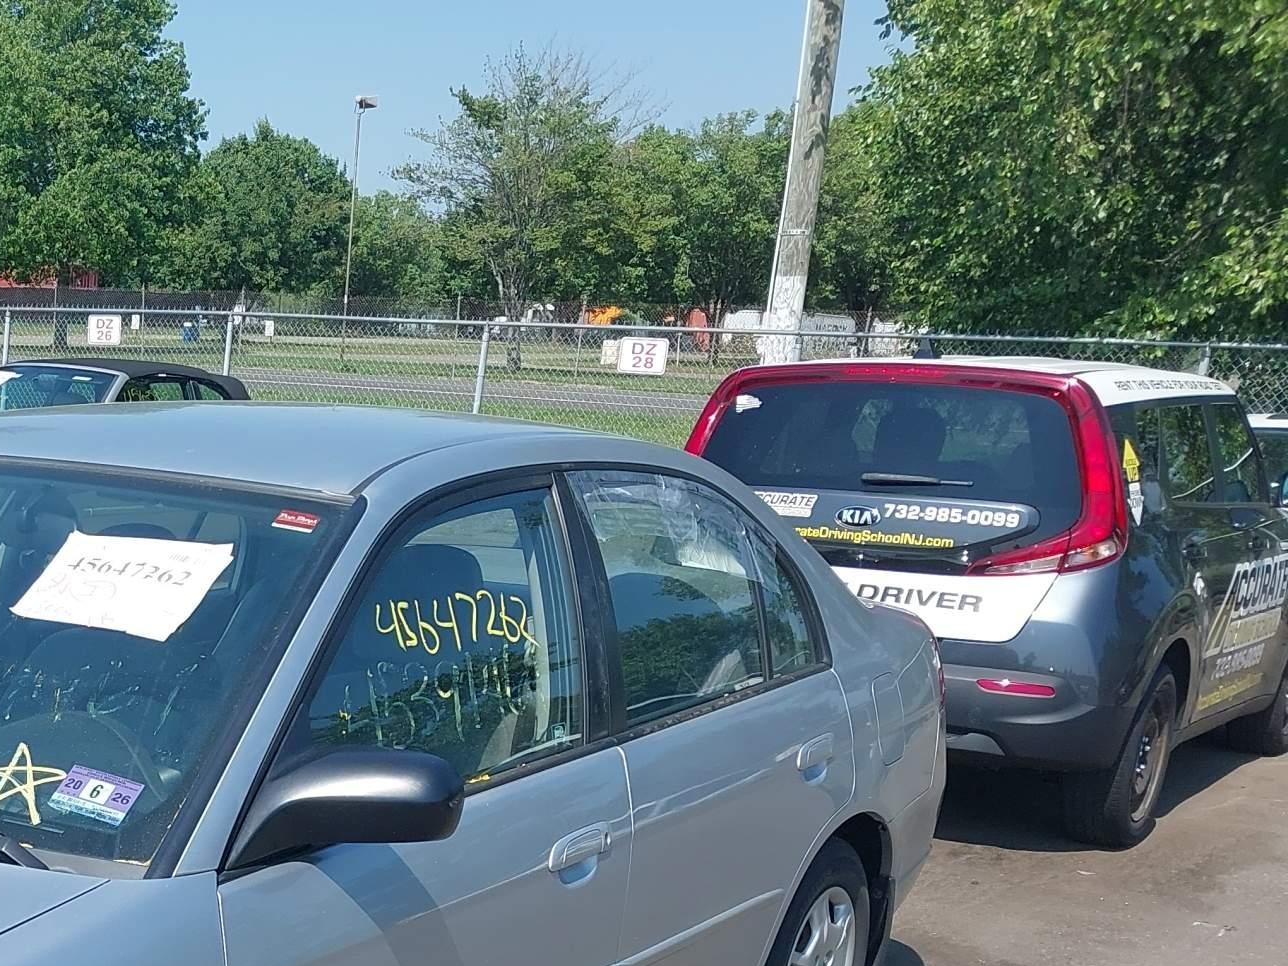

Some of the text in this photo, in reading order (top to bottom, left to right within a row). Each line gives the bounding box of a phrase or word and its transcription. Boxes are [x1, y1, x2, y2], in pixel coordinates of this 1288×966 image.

[96, 318, 114, 329] DZ
[96, 330, 112, 341] 26
[631, 342, 658, 355] DZ
[631, 355, 654, 369] 28
[843, 509, 872, 525] KIA
[883, 503, 1020, 529] 732-985-0099
[857, 583, 983, 613] DRIVER
[375, 589, 541, 655] 45647262
[64, 778, 83, 790] 20
[89, 784, 104, 799] 6
[111, 792, 132, 805] 26
